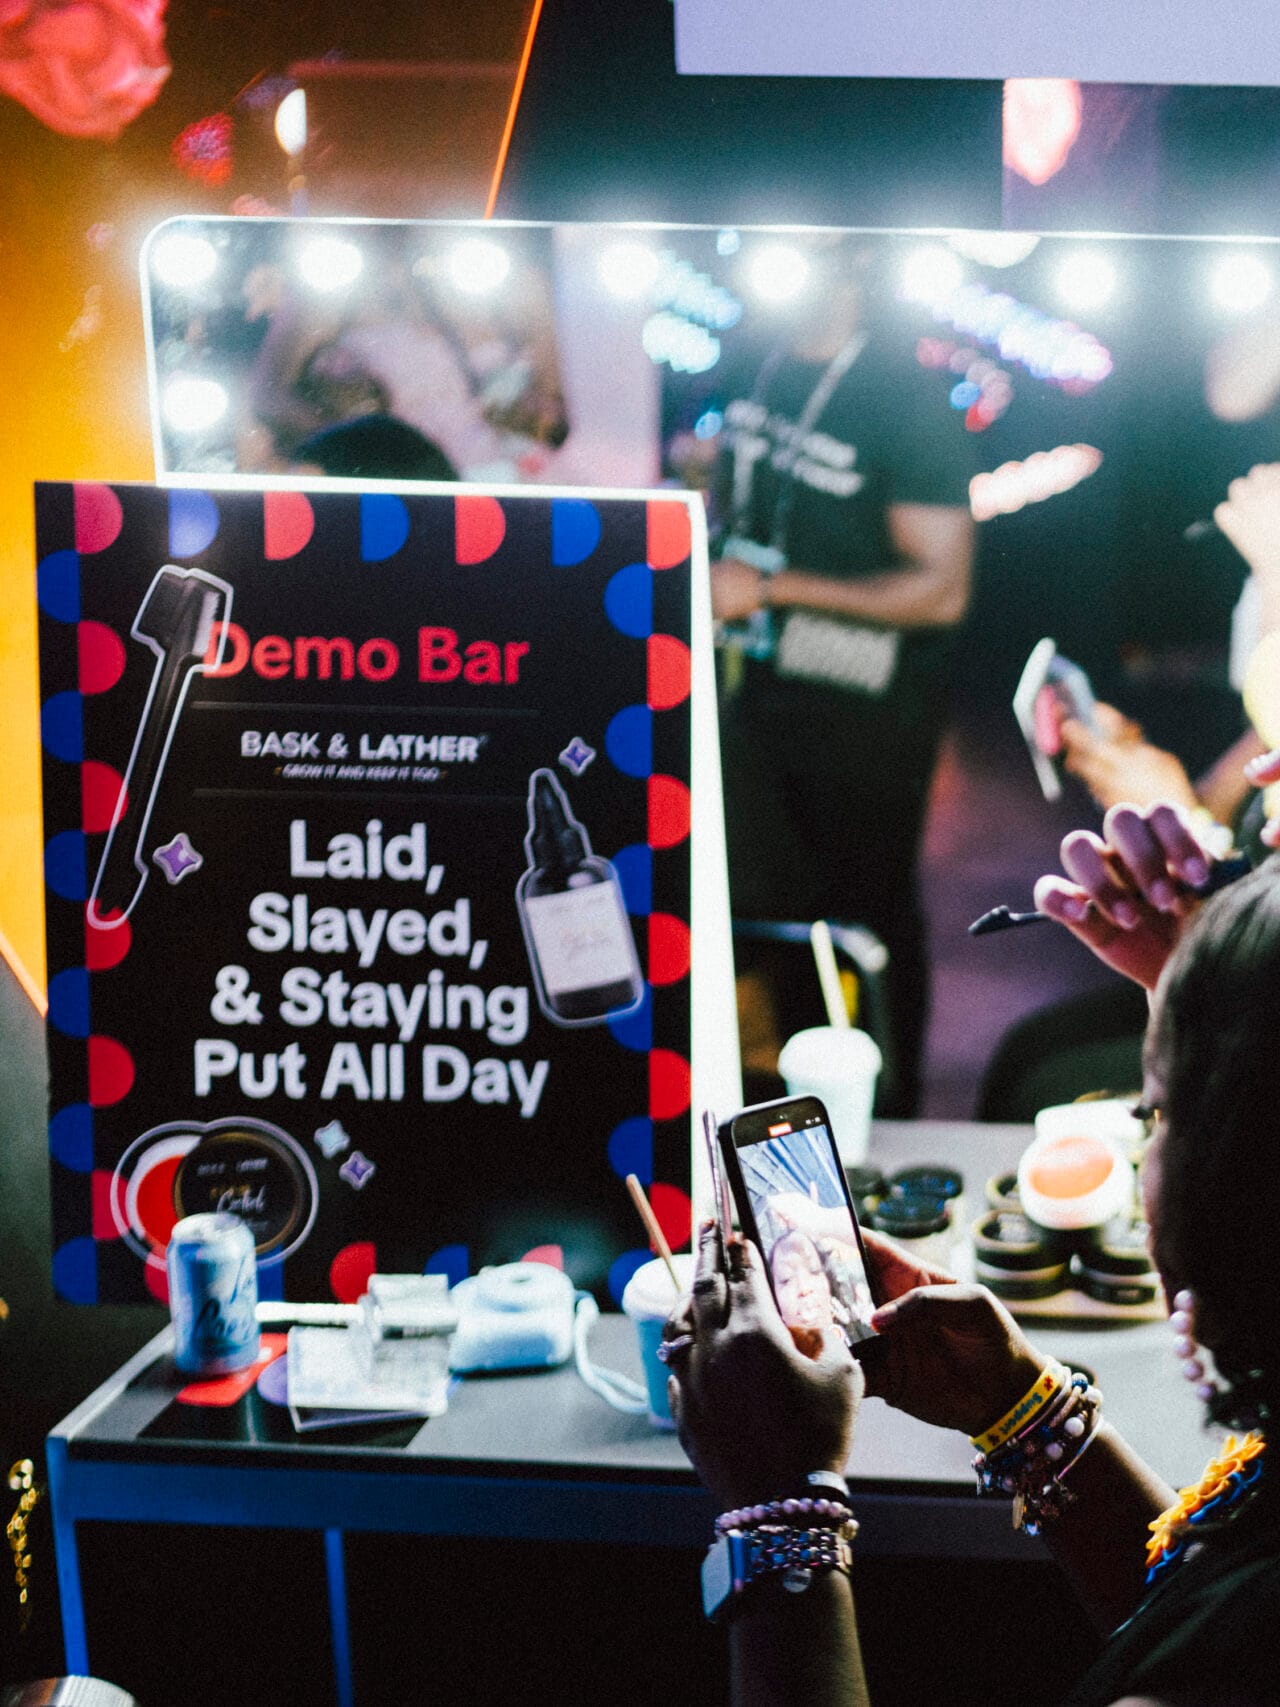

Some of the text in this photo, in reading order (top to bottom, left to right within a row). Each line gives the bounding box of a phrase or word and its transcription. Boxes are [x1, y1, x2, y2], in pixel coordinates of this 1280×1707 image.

[202, 621, 530, 685] Demo Bar
[240, 730, 321, 759] BASK
[327, 733, 349, 760] &
[289, 819, 446, 895] Laid,
[246, 891, 489, 971] Slayed,
[209, 965, 530, 1046] & Staying
[193, 1038, 550, 1119] Put All Day
